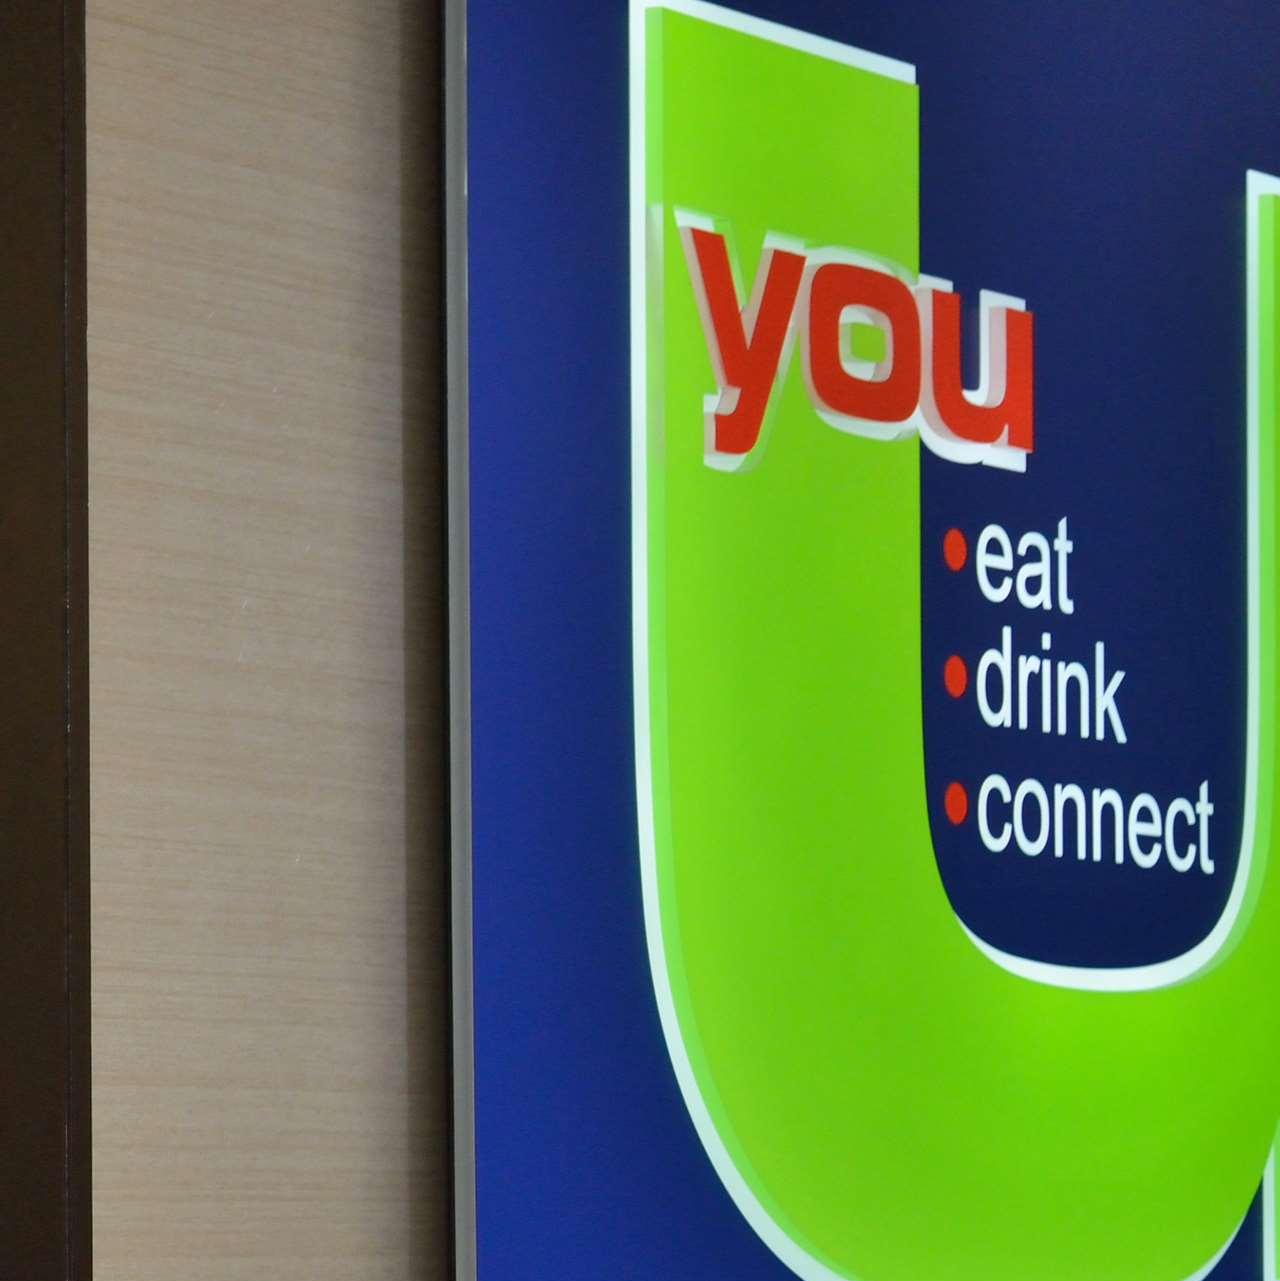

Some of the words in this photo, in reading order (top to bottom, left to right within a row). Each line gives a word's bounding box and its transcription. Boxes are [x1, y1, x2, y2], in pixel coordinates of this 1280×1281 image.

[674, 206, 1034, 473] you
[975, 516, 1075, 614] eat
[975, 625, 1128, 744] drink
[976, 773, 1215, 875] connect
